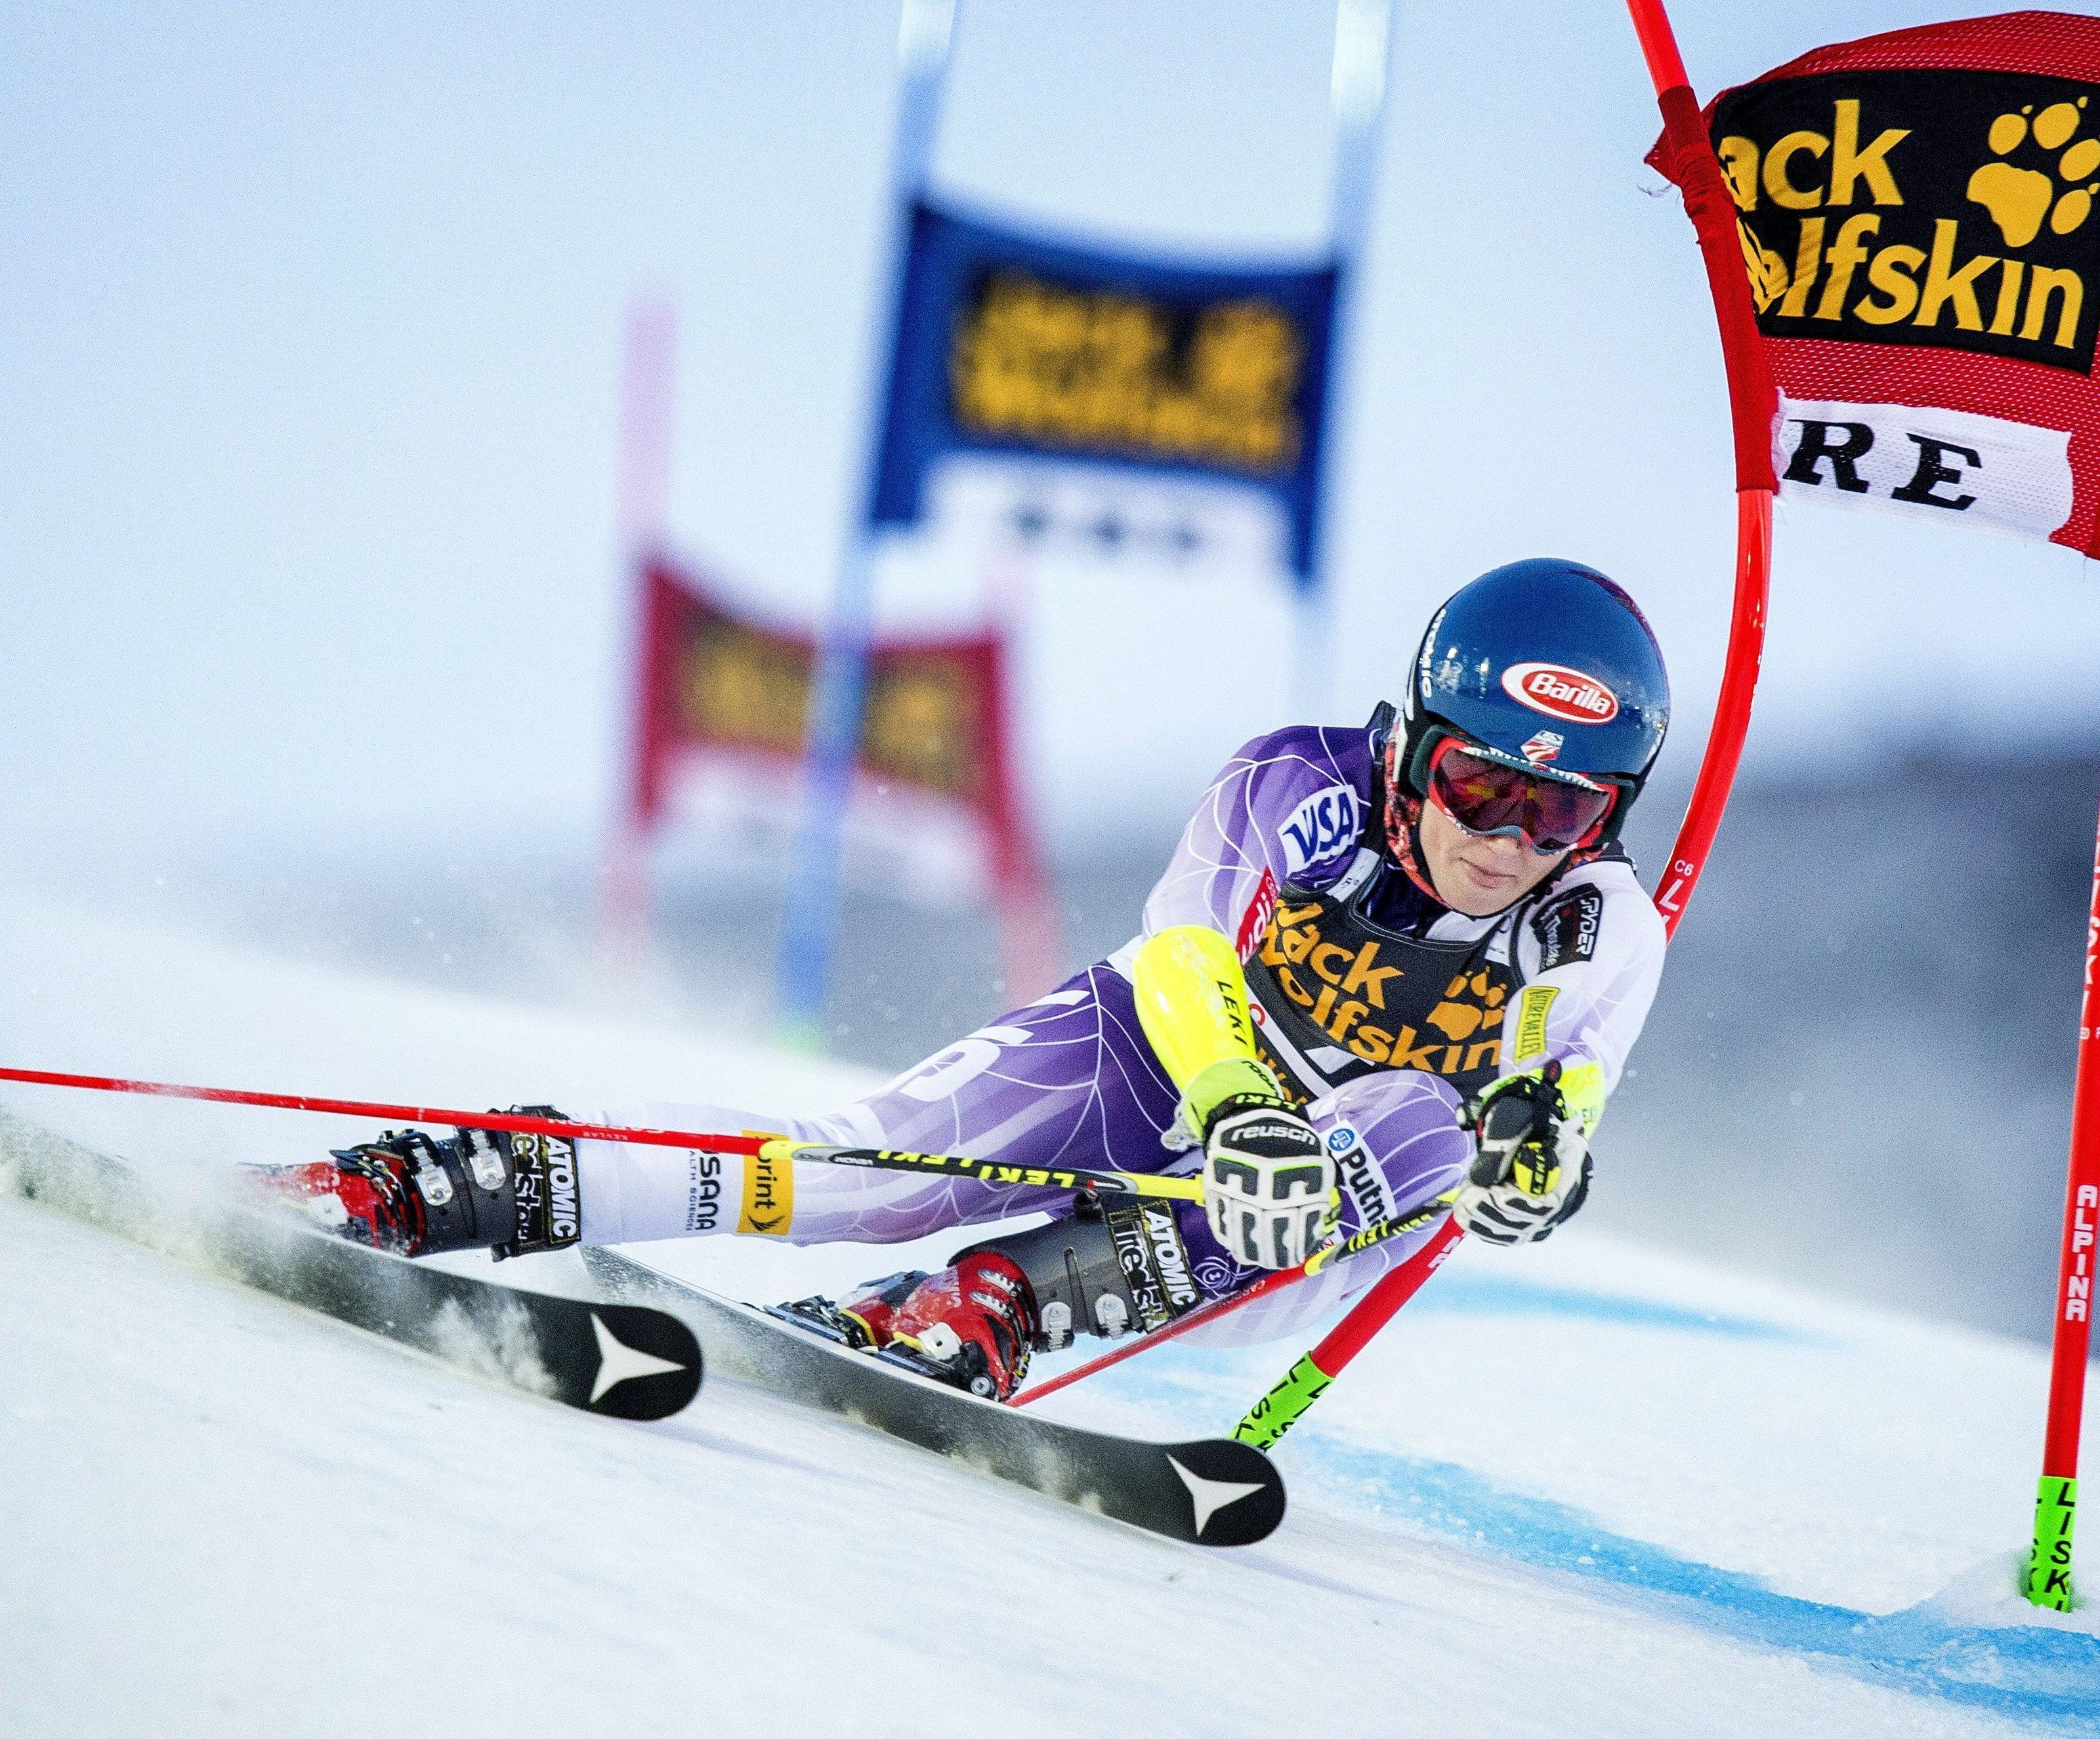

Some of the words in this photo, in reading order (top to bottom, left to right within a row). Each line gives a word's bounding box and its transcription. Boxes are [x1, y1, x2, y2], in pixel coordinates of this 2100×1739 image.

[1718, 99, 1913, 211] ack
[1528, 673, 1612, 715] Barilla
[1282, 792, 1354, 863] VISA
[1674, 858, 1694, 877] C6
[1217, 980, 1248, 1046] LEKI
[1231, 1125, 1316, 1145] reusch
[545, 1135, 577, 1238] ATOMIC
[695, 1150, 721, 1230] SANA
[755, 1156, 778, 1209] rint
[978, 1165, 1076, 1188] LEKI
[1339, 1147, 1389, 1227] Putn
[1144, 1209, 1196, 1306] ATOMIC
[2065, 1184, 2098, 1322] ALPINA
